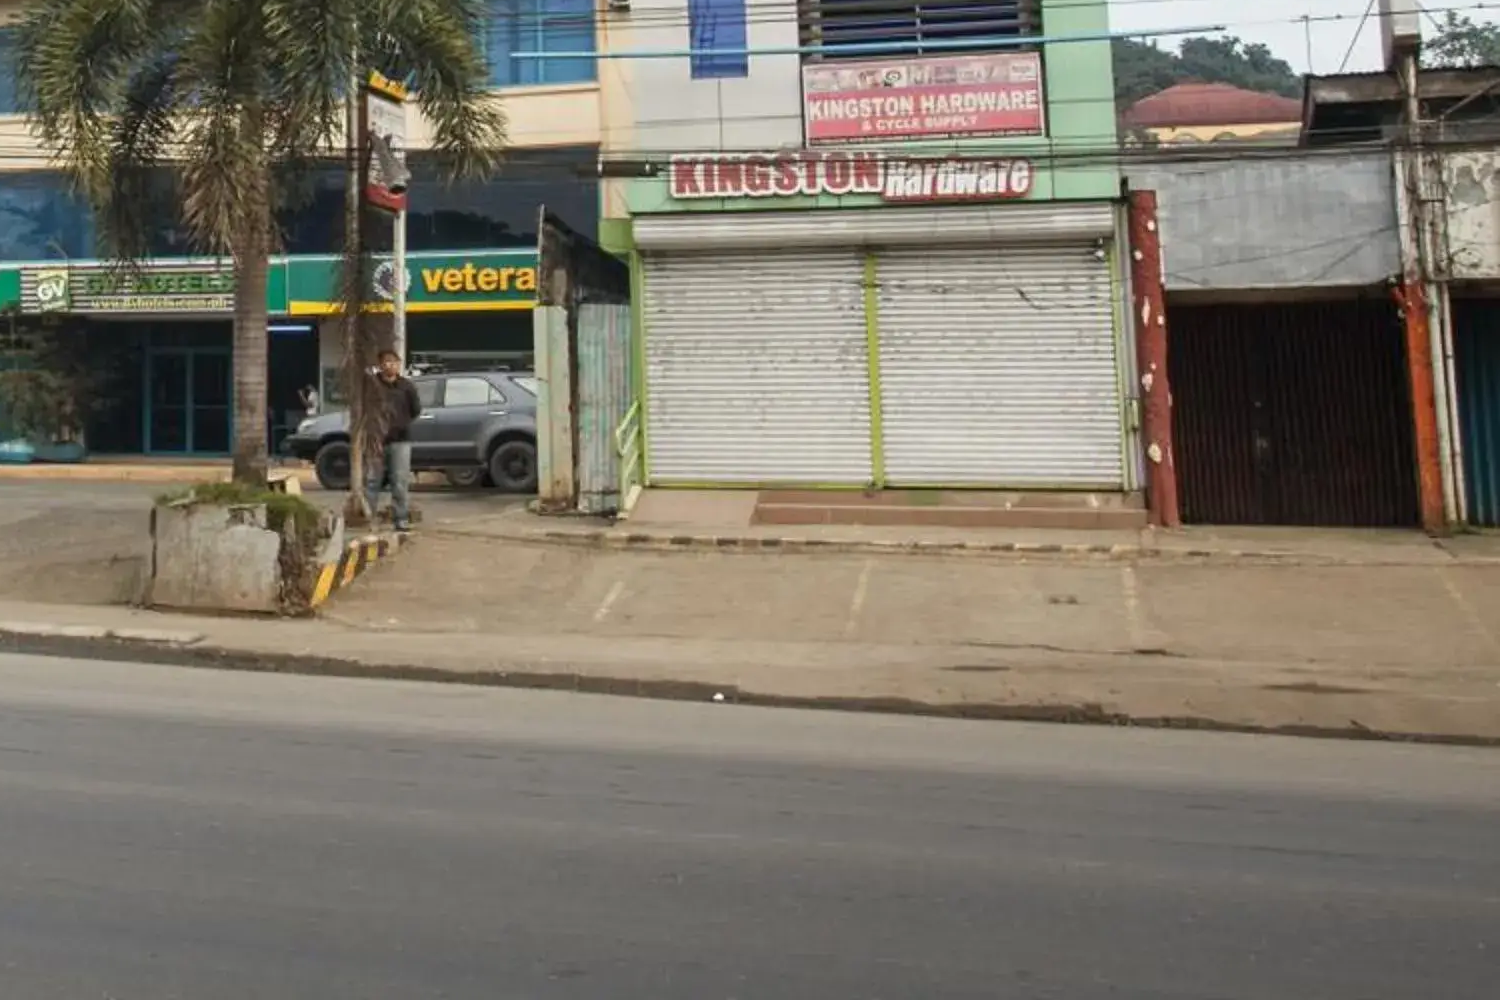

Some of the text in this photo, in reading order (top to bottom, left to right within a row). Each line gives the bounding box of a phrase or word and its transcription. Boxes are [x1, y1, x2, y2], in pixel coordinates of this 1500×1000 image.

[809, 89, 1039, 121] KINGSTON HARDWARE
[876, 118, 923, 130] CYCLE
[925, 115, 978, 128] SUPPLY
[671, 151, 1031, 198] KINGSTON Hardware
[37, 279, 65, 301] GV
